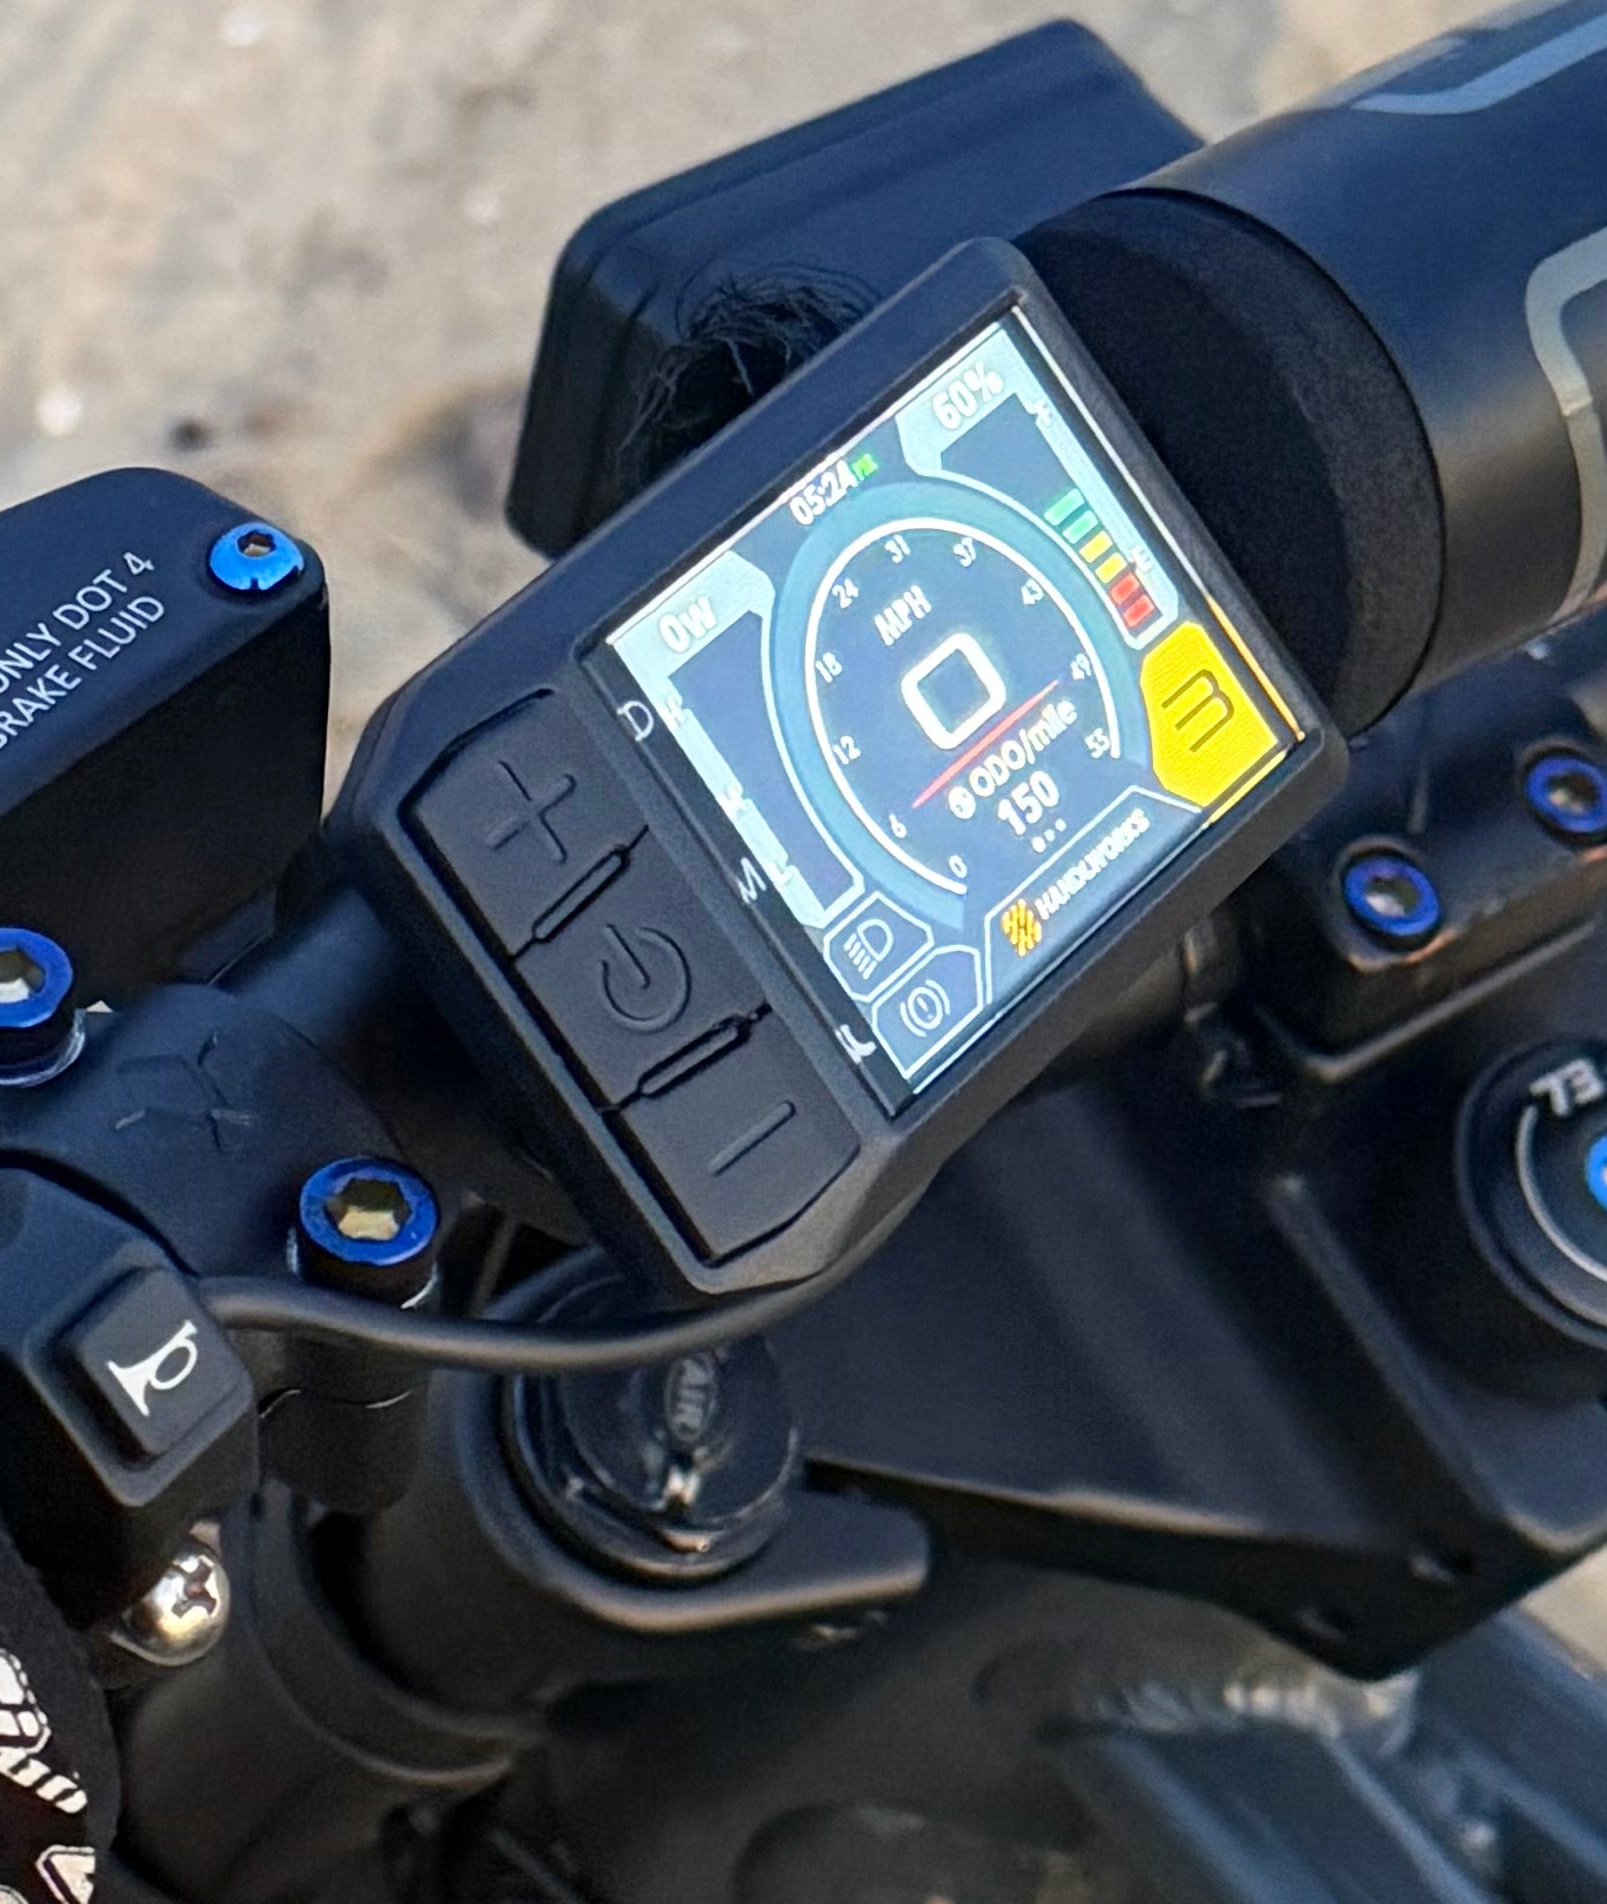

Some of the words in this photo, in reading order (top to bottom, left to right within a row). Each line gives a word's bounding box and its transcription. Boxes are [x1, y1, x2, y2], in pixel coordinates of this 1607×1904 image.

[932, 361, 1004, 430] 60%
[790, 459, 859, 525] 05:24
[884, 534, 911, 563] 31
[952, 536, 978, 568] 37
[52, 568, 128, 630] DOT
[122, 551, 155, 576] 4
[831, 577, 859, 609] 24
[68, 596, 165, 670] FLUID
[873, 584, 933, 646] MPH
[814, 652, 843, 683] 18
[900, 631, 1007, 751] 0
[832, 734, 862, 765] 12
[968, 699, 1079, 798] ODO/mile
[1083, 727, 1111, 760] 55
[888, 813, 908, 839] 6
[996, 770, 1060, 836] 150
[947, 854, 969, 879] 0
